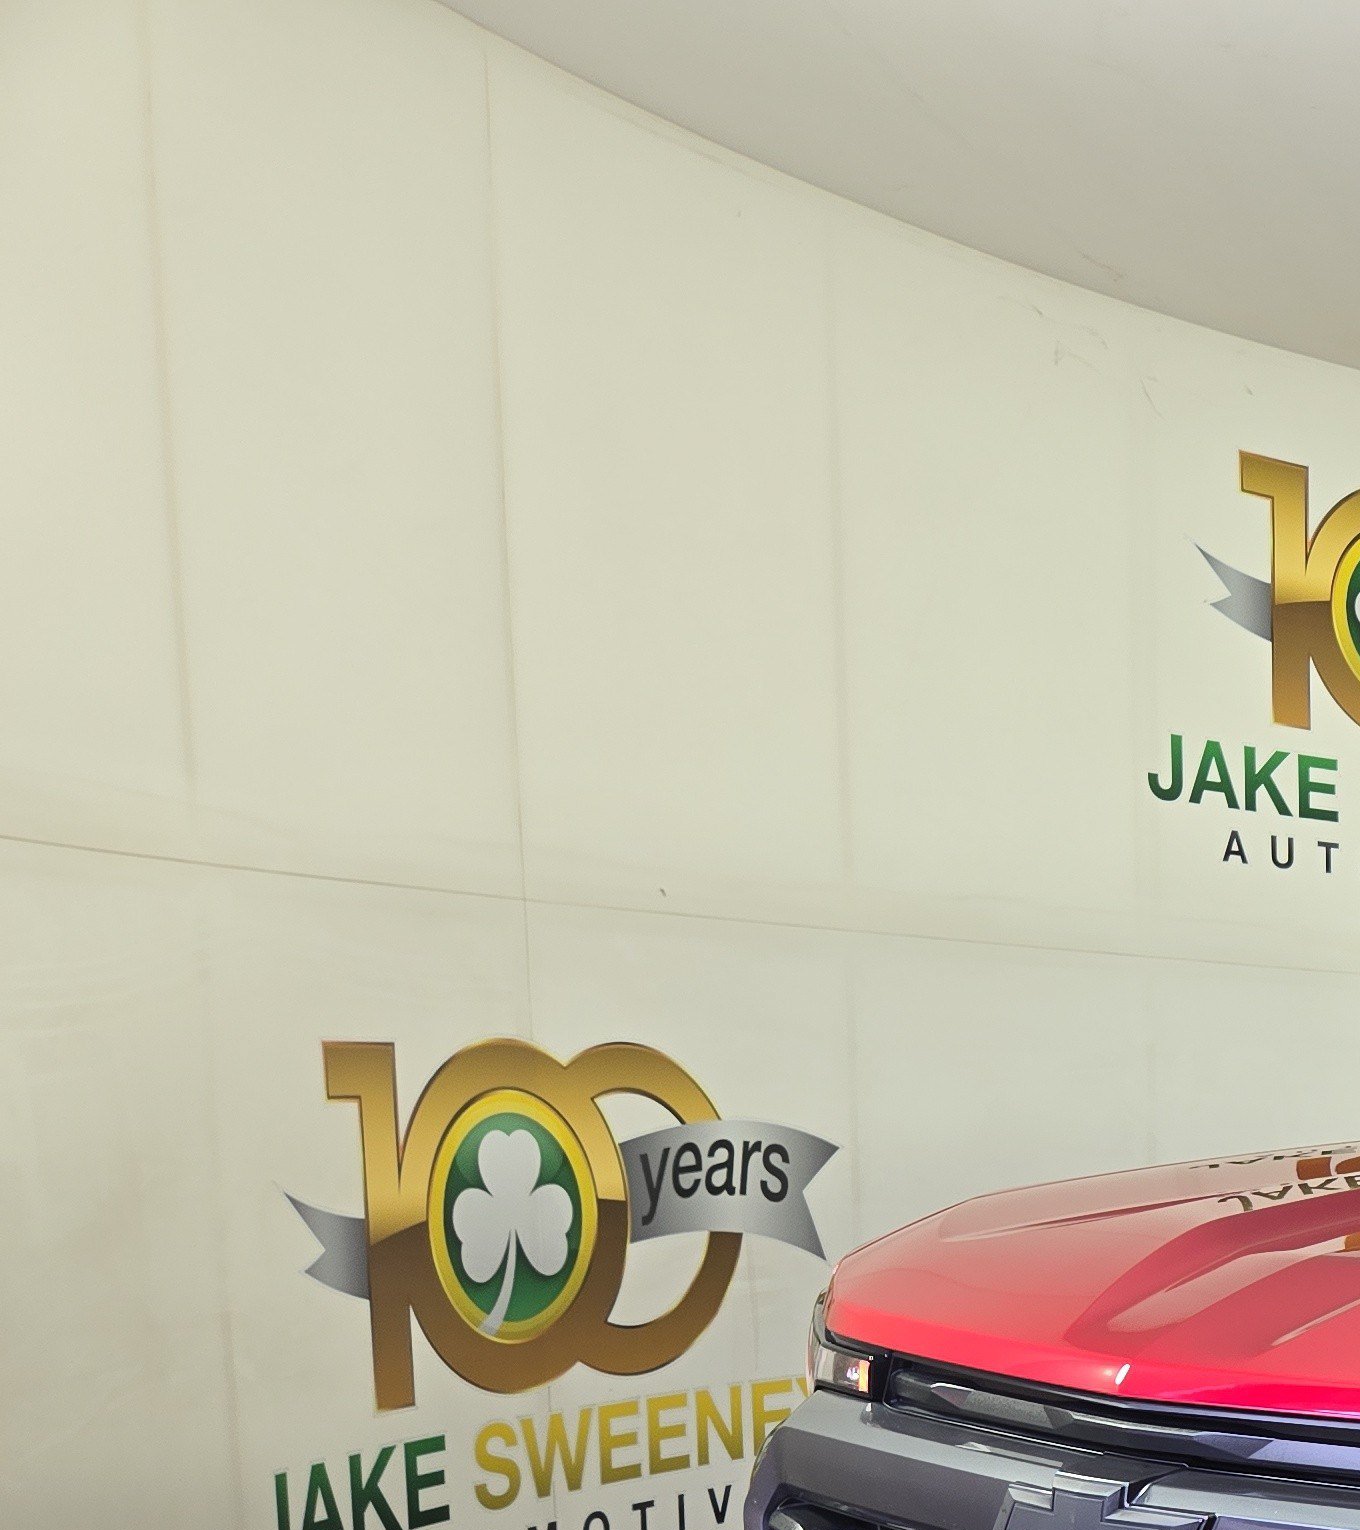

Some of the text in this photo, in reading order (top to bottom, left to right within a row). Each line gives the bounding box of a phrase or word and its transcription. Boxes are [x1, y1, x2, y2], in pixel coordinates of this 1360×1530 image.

[1148, 733, 1339, 823] JAKE
[321, 1037, 790, 1413] 100 years
[473, 1377, 809, 1511] SWEENE
